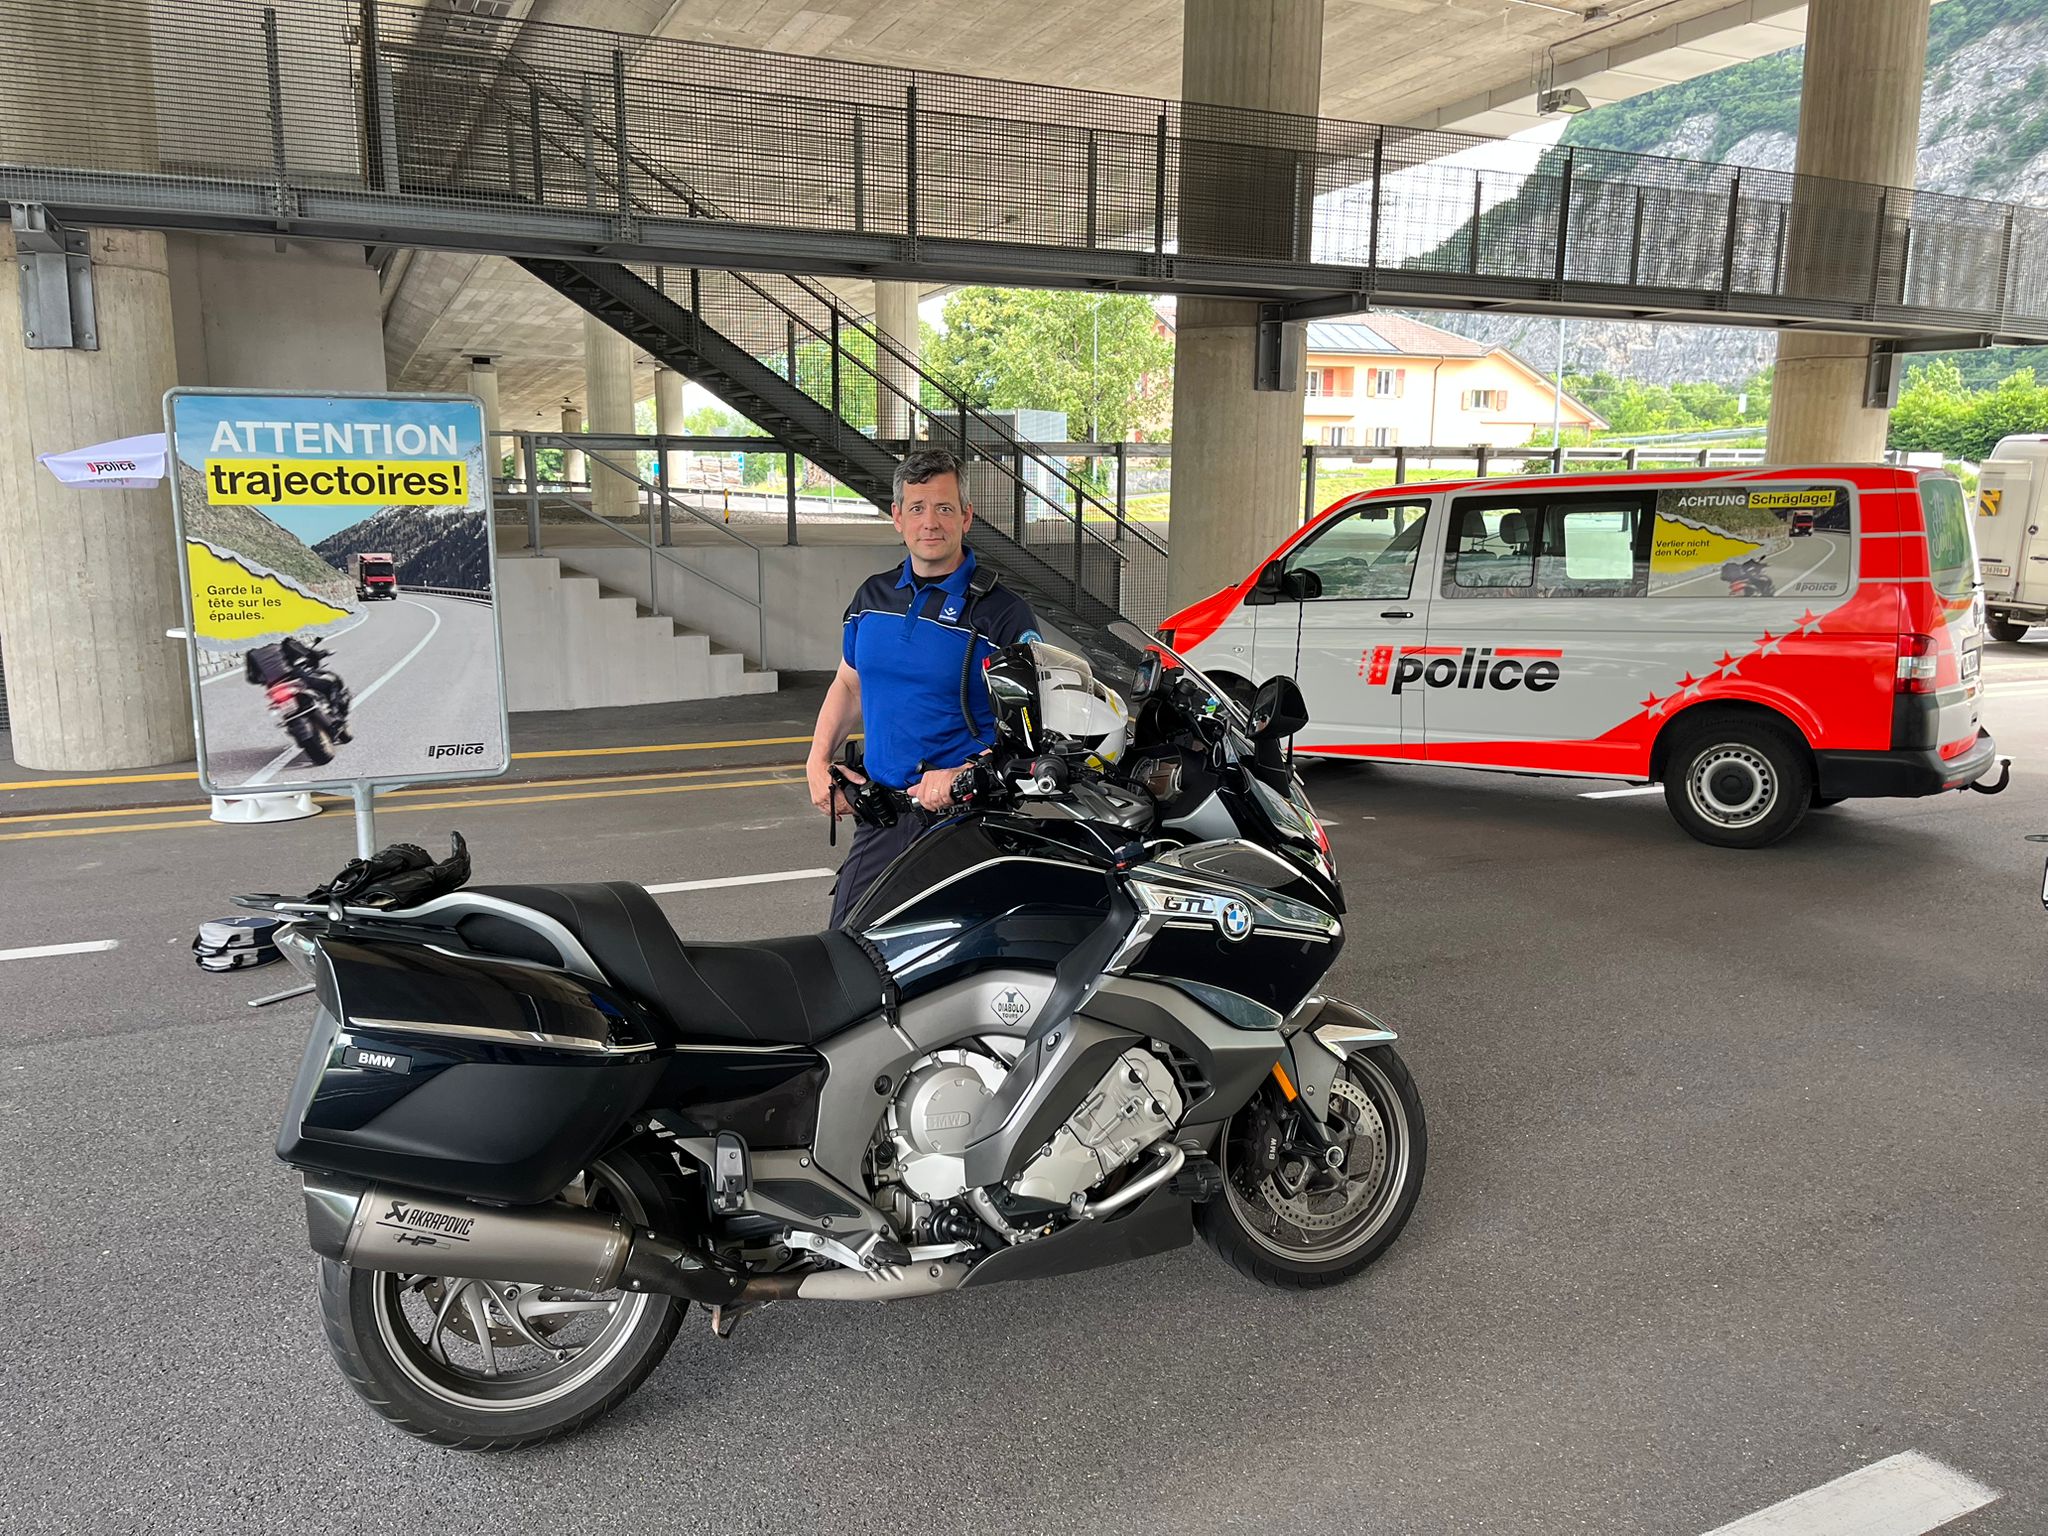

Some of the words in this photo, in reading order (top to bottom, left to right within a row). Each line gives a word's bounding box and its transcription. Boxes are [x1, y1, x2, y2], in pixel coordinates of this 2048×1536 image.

[209, 420, 458, 456] ATTENTION
[95, 461, 136, 475] police
[210, 463, 463, 502] trajectoires!
[1677, 495, 1746, 507] ACHTUNG
[1751, 492, 1833, 506] Schräglage!
[1656, 540, 1686, 548] Verlier
[1687, 540, 1710, 548] nicht
[1674, 549, 1699, 557] Kopf.
[207, 585, 247, 595] Garde
[251, 585, 263, 594] la
[1801, 582, 1838, 593] police
[208, 598, 234, 608] tête
[262, 597, 282, 607] les
[209, 610, 265, 623] épaules.
[1391, 647, 1561, 695] police
[436, 743, 485, 760] police
[1163, 896, 1215, 914] GTL
[358, 1052, 396, 1068] BMW
[1268, 1137, 1277, 1160] BMW
